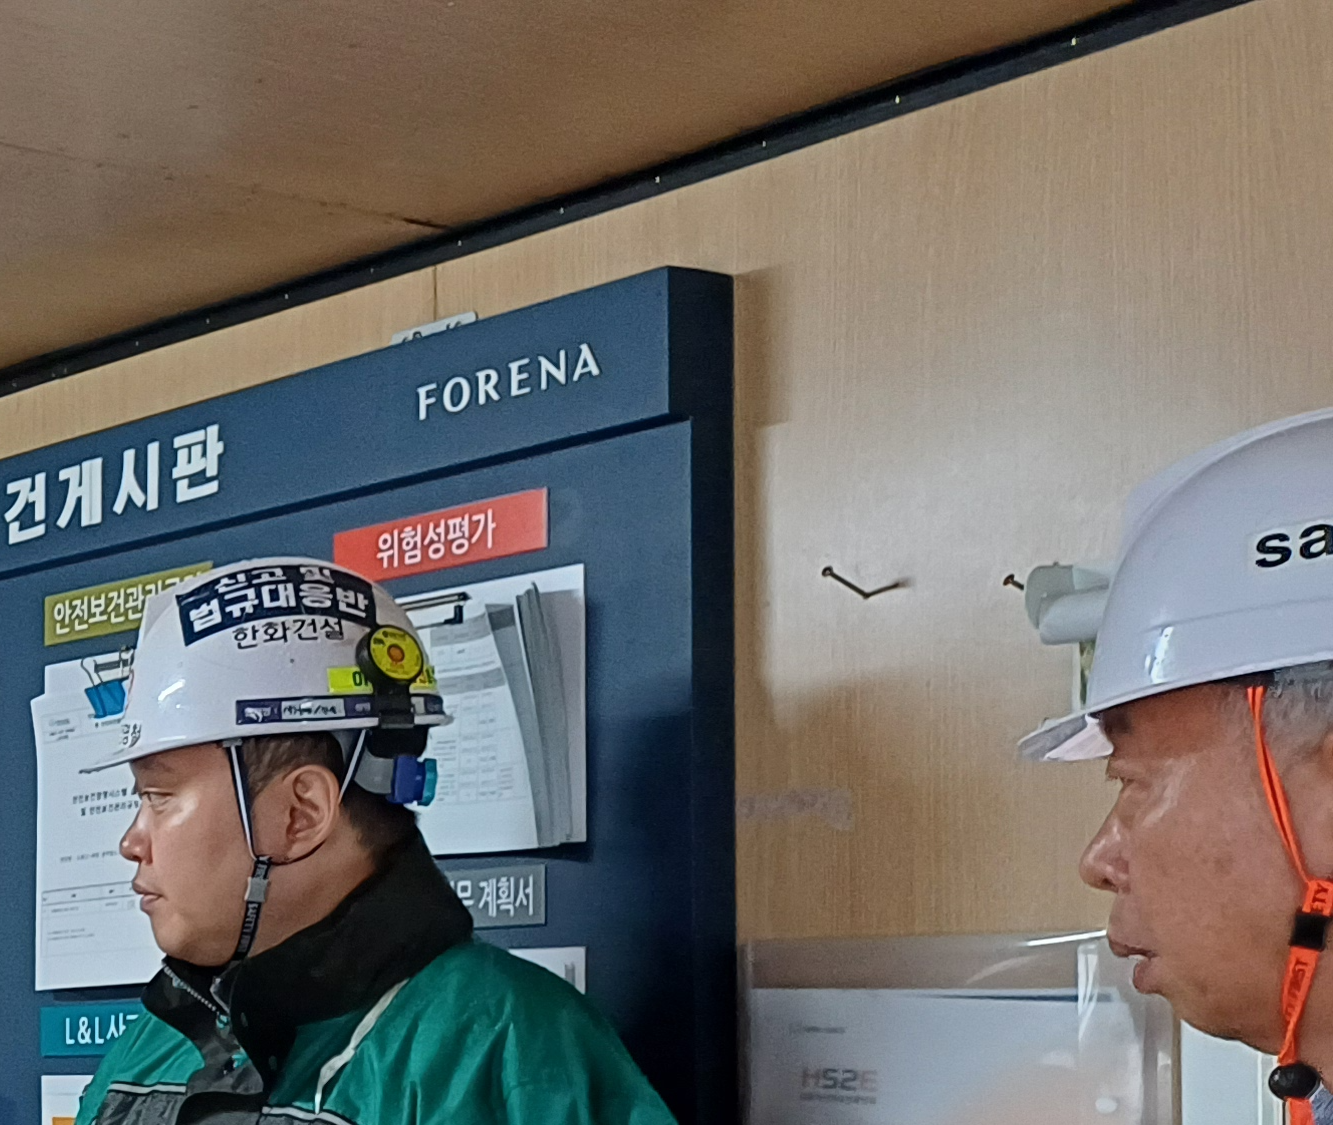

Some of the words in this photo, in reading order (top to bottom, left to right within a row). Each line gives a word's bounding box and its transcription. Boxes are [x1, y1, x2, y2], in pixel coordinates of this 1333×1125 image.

[417, 343, 601, 421] FORENA
[376, 508, 497, 569] 위험성평가
[189, 582, 369, 633] 법규대응반
[232, 617, 344, 650] 한화건설
[478, 874, 533, 917] 계획서
